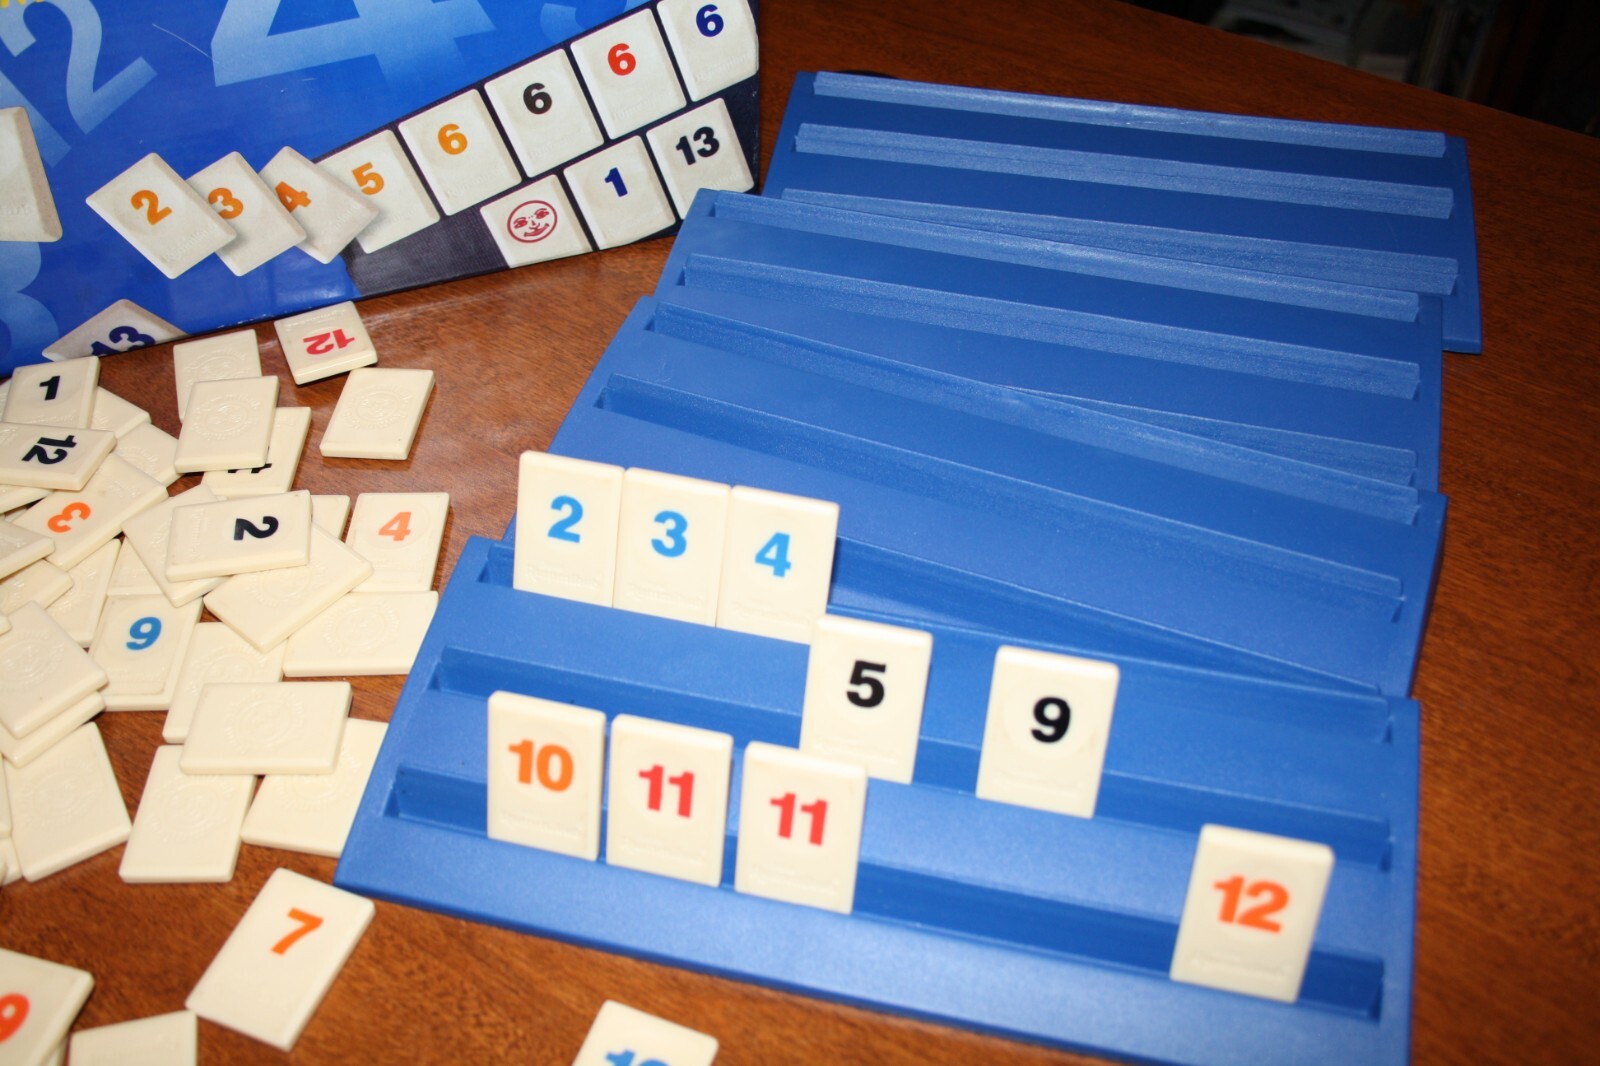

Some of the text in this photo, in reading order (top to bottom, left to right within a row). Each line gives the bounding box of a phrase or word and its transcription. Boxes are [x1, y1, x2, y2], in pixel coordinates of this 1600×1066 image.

[695, 4, 724, 38] 6
[607, 43, 637, 76] 6
[523, 82, 553, 115] 6
[437, 123, 468, 156] 6
[675, 126, 720, 166] 13
[352, 162, 385, 196] 5
[604, 167, 628, 198] 1
[130, 189, 172, 225] 2
[207, 187, 244, 220] 3
[275, 181, 312, 212] 4
[303, 328, 355, 355] 12
[39, 375, 61, 401] 1
[21, 434, 77, 465] 12
[46, 500, 93, 534] 3
[234, 516, 279, 541] 2
[378, 511, 412, 542] 4
[546, 494, 585, 544] 2
[650, 509, 689, 559] 3
[753, 530, 793, 579] 4
[126, 616, 163, 652] 9
[847, 660, 886, 708] 5
[1031, 697, 1071, 743] 9
[507, 738, 575, 793] 10
[638, 764, 695, 818] 11
[770, 792, 828, 846] 11
[1212, 874, 1291, 935] 12
[270, 907, 324, 957] 7
